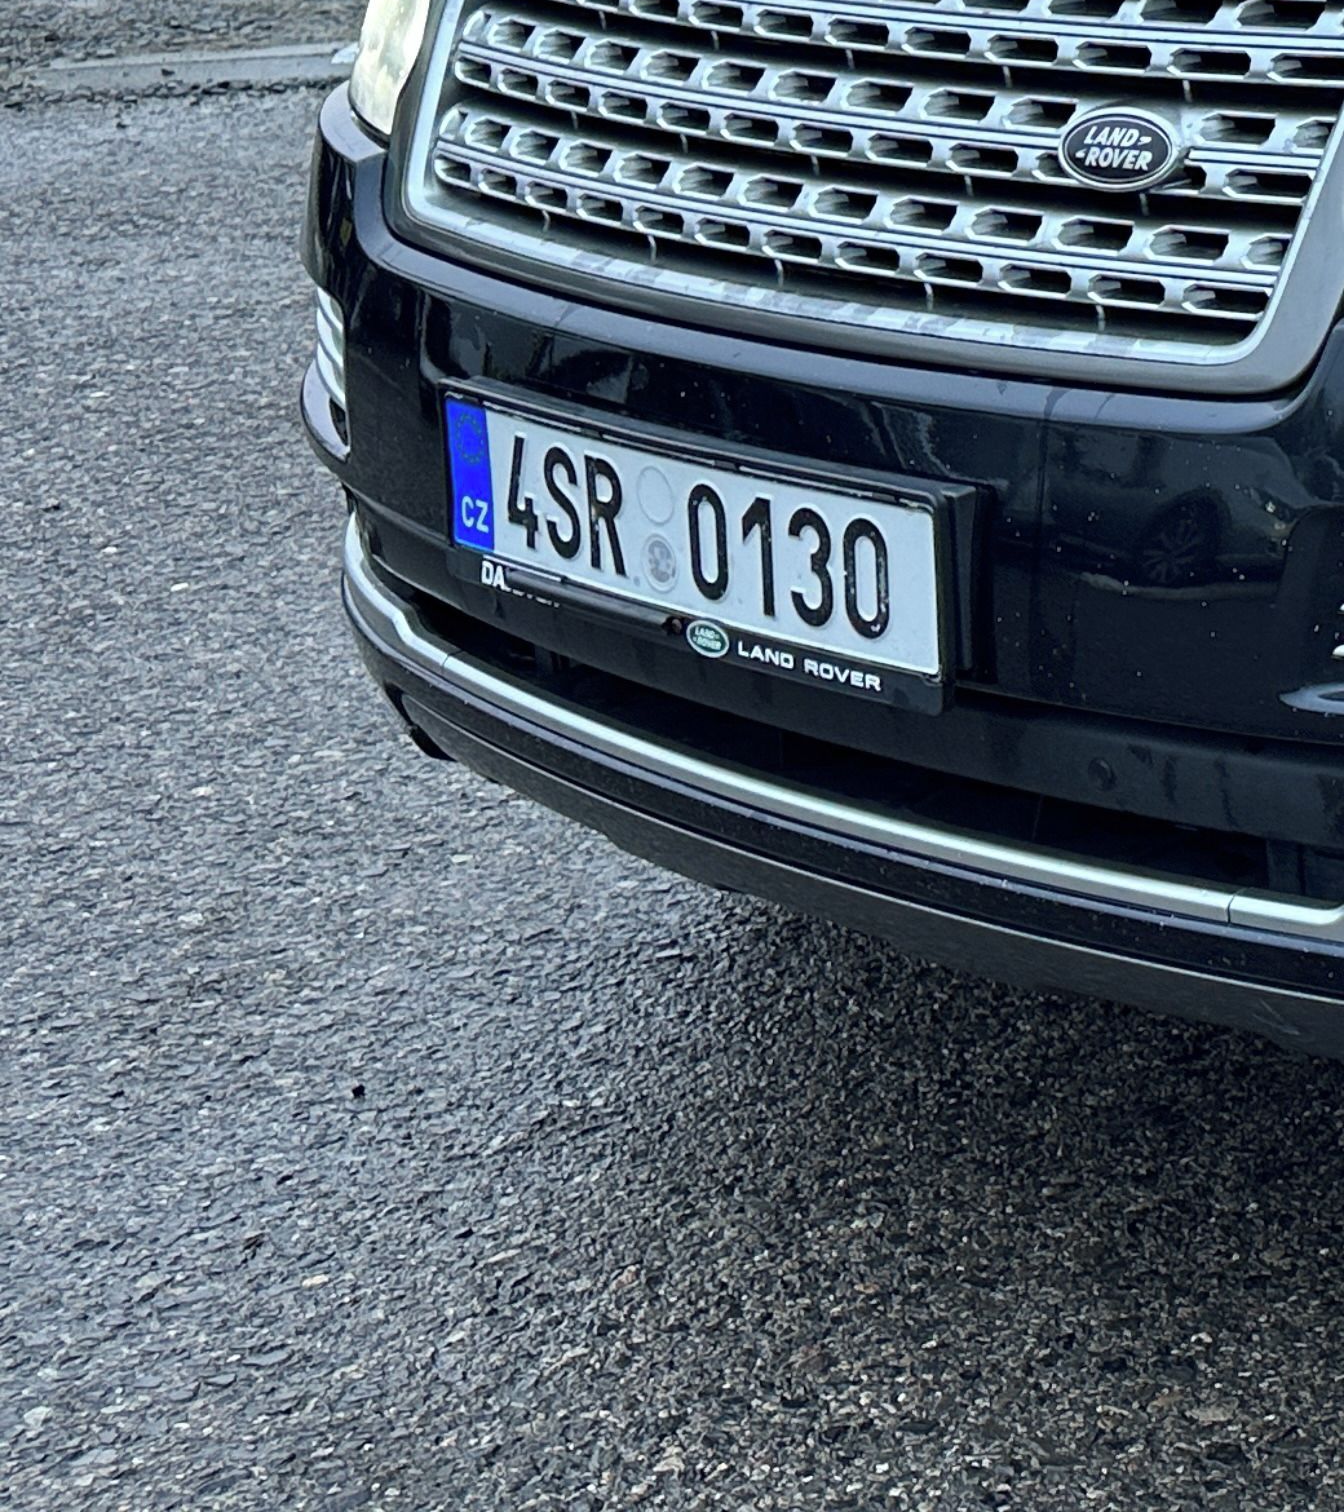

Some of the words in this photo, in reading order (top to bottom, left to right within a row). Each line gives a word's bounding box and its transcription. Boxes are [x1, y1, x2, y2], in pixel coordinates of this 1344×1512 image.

[1084, 126, 1140, 147] LAND
[1084, 146, 1153, 171] ROVER
[462, 495, 489, 534] CZ
[507, 431, 628, 578] 4SR
[687, 482, 890, 639] 0130
[696, 627, 716, 639] LAND
[737, 640, 795, 670] LAND
[803, 657, 882, 692] ROVER
